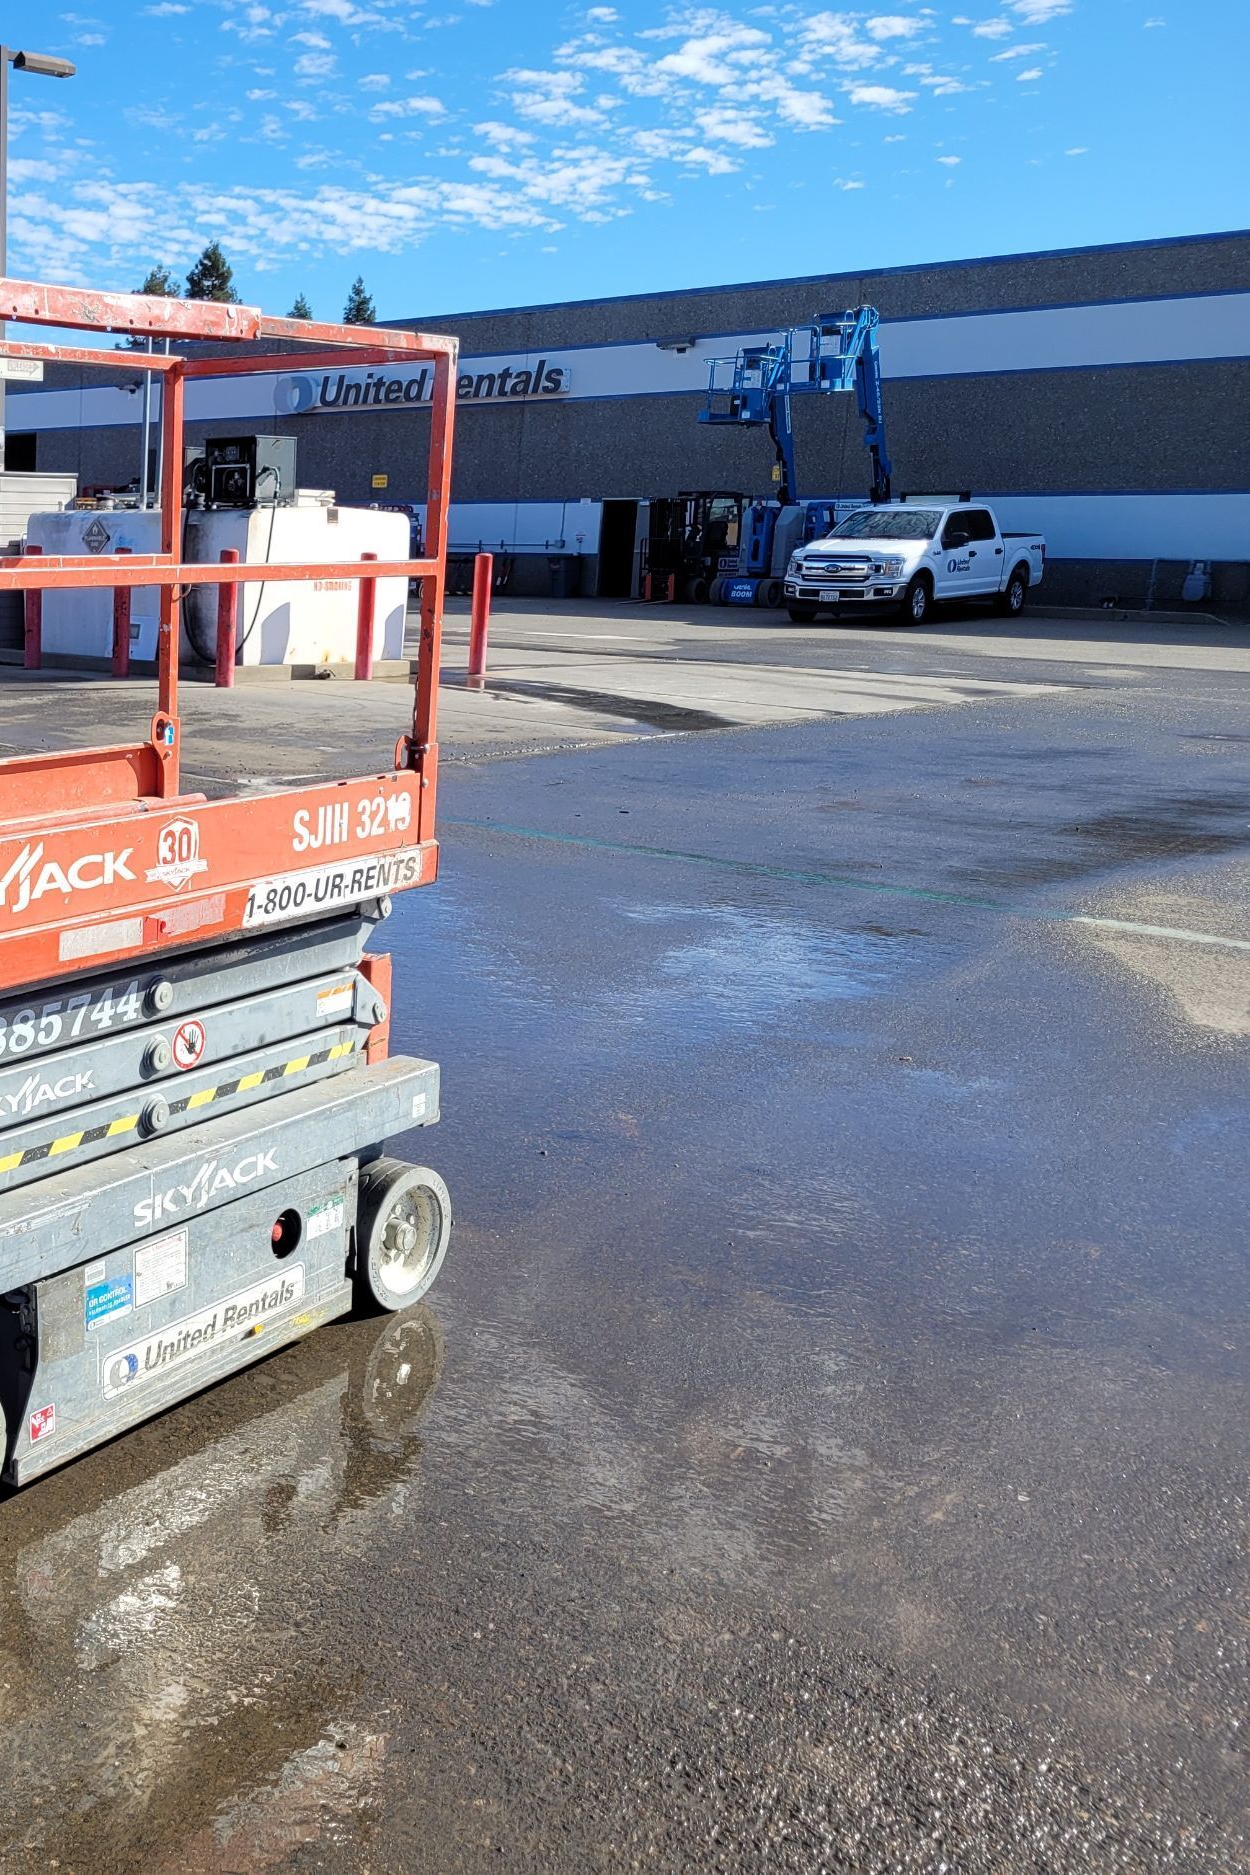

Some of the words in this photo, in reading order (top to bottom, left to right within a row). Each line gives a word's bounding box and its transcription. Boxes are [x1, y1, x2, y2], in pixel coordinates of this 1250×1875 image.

[319, 368, 428, 407] United
[430, 359, 564, 400] entals
[162, 826, 192, 865] 30
[247, 855, 417, 919] 1-800-UR-RENTS
[133, 1146, 280, 1228] SKYJACK
[144, 1313, 218, 1371] United
[221, 1279, 295, 1332] Rentals
